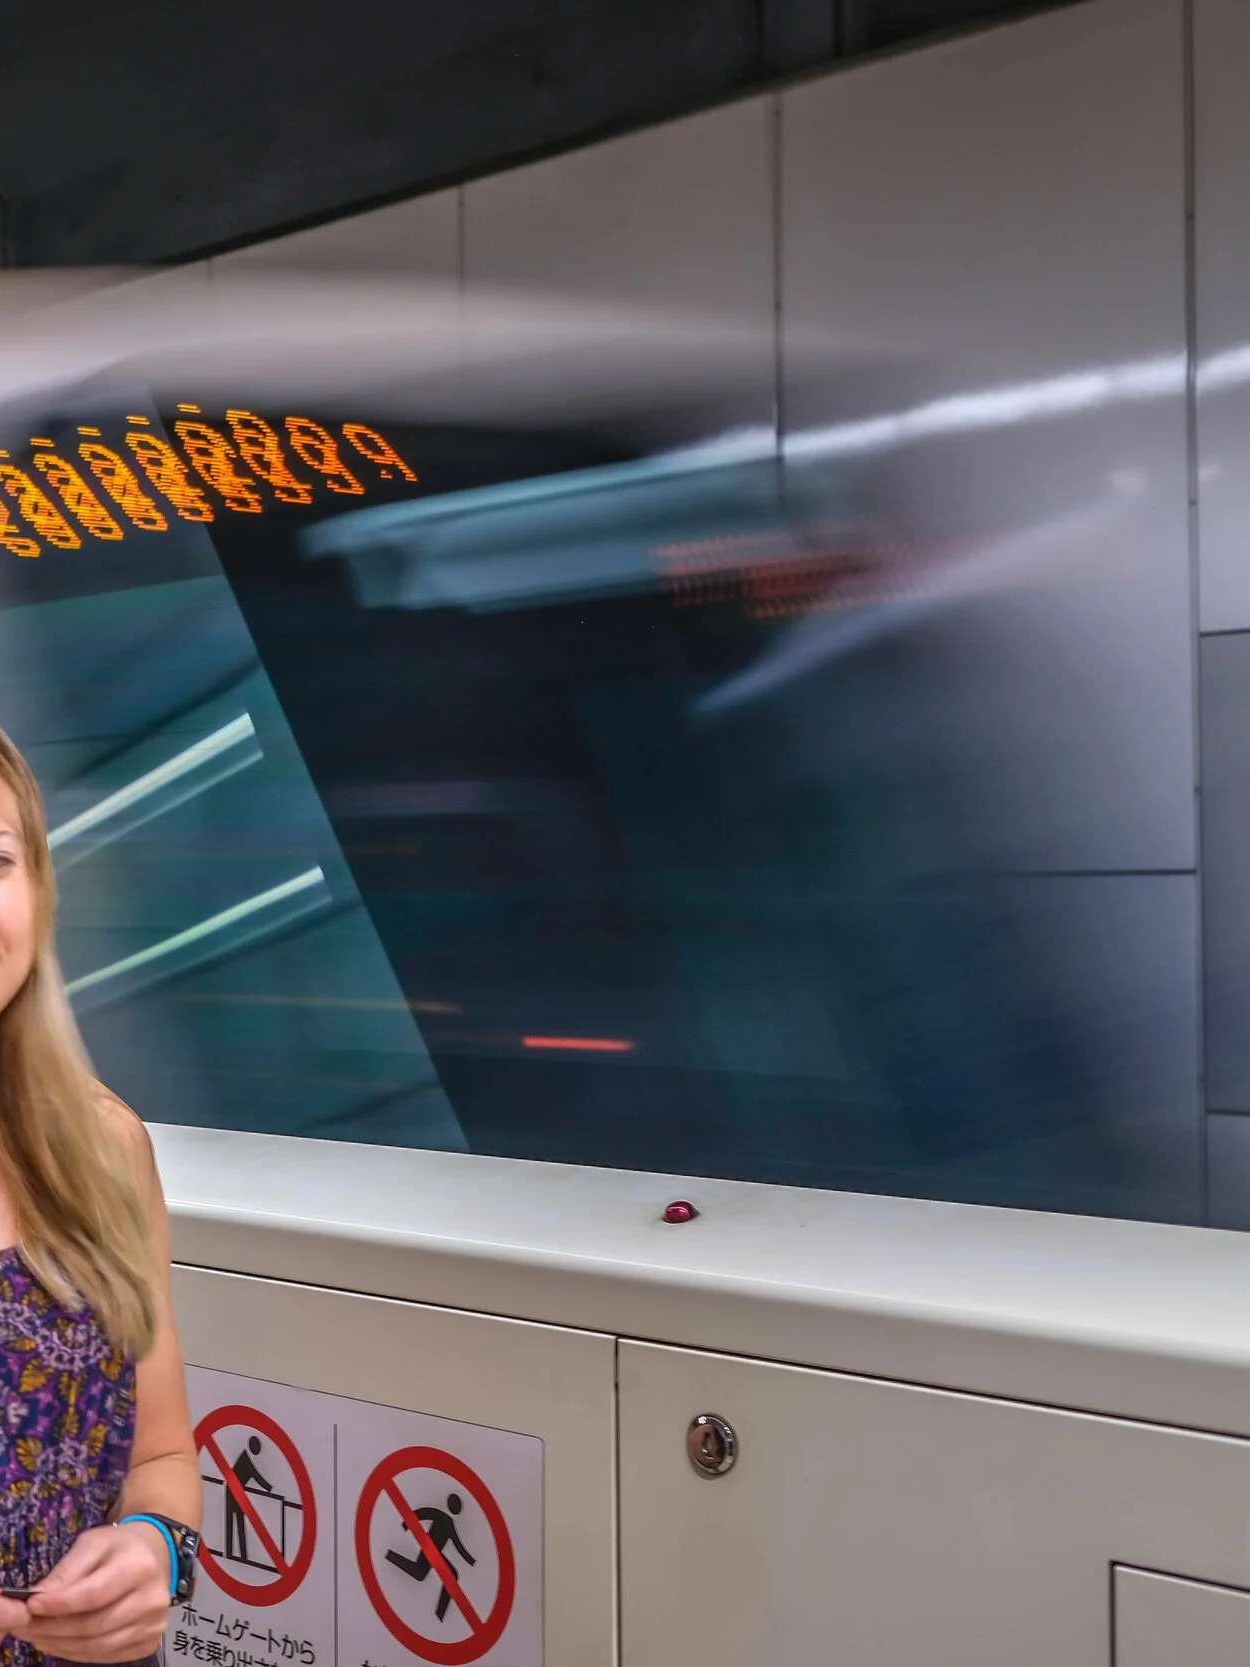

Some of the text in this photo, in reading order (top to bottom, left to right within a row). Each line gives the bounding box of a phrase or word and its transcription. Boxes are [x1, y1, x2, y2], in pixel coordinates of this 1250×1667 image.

[173, 1630, 279, 1667] 身を乗り出
[182, 1604, 315, 1665] ホームゲートから
